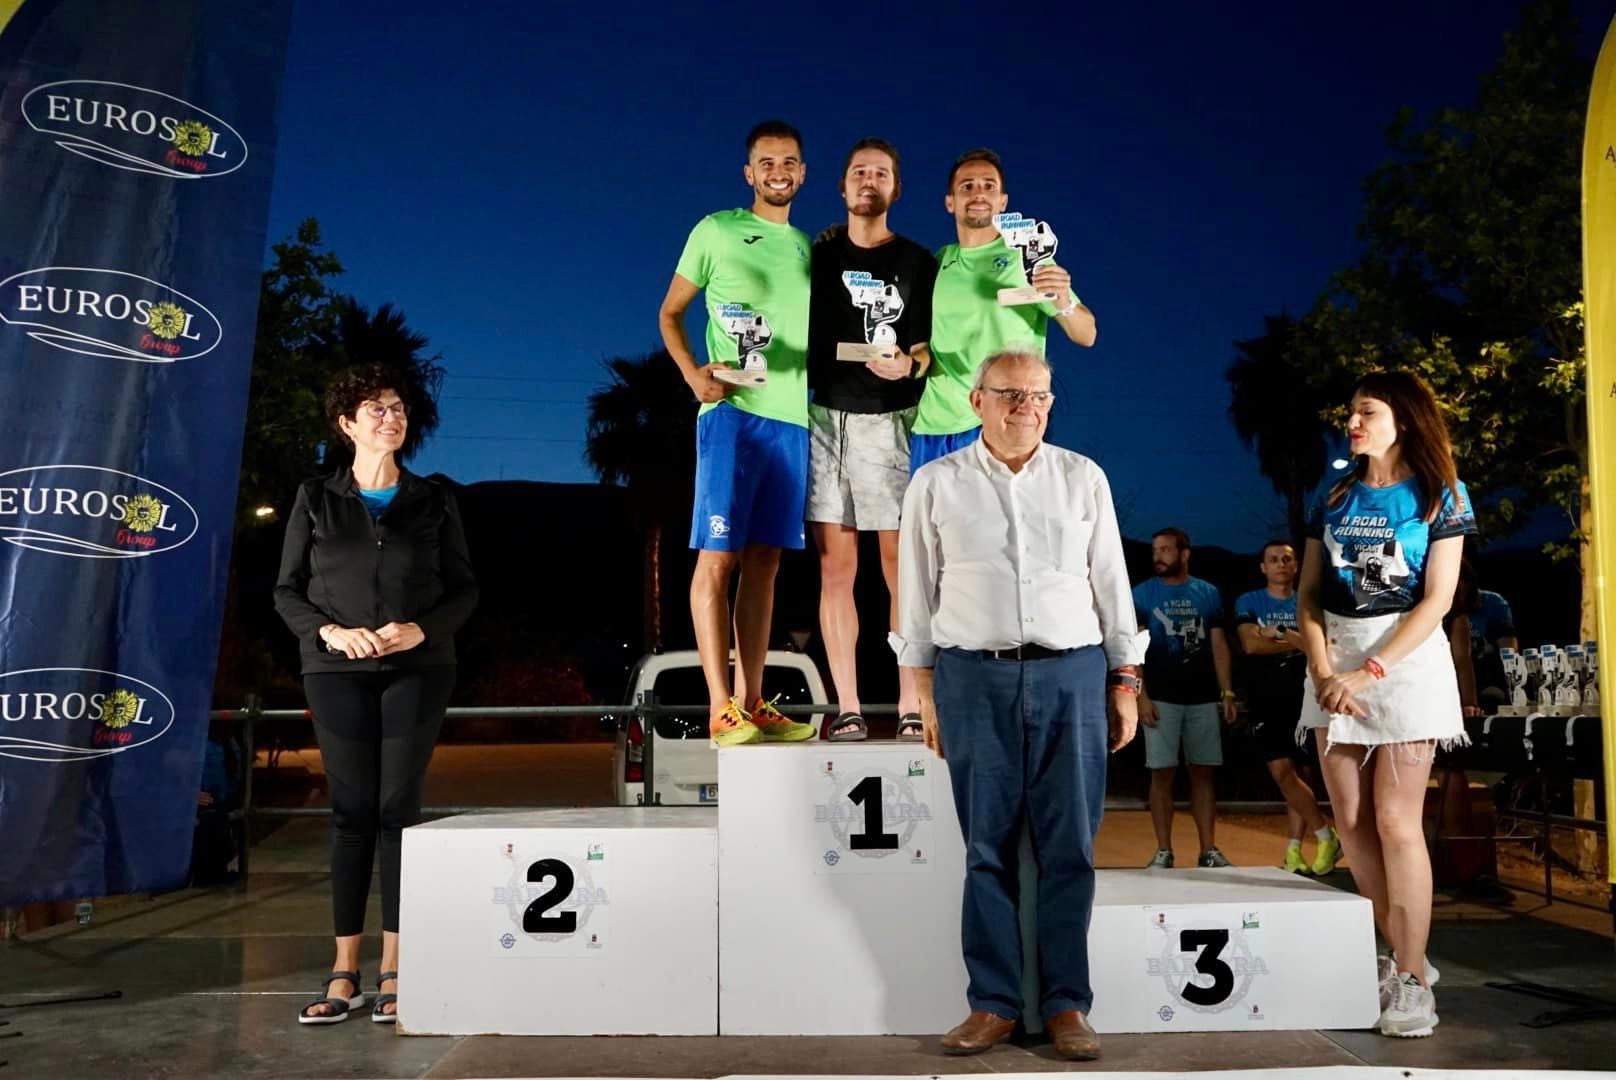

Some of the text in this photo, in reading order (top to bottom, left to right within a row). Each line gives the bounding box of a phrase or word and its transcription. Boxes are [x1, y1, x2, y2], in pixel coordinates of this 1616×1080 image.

[1334, 526, 1395, 538] RUNNING
[1351, 515, 1387, 527] ROAD
[847, 776, 899, 850] 1
[523, 858, 577, 934] 2
[1180, 928, 1234, 1006] 3
